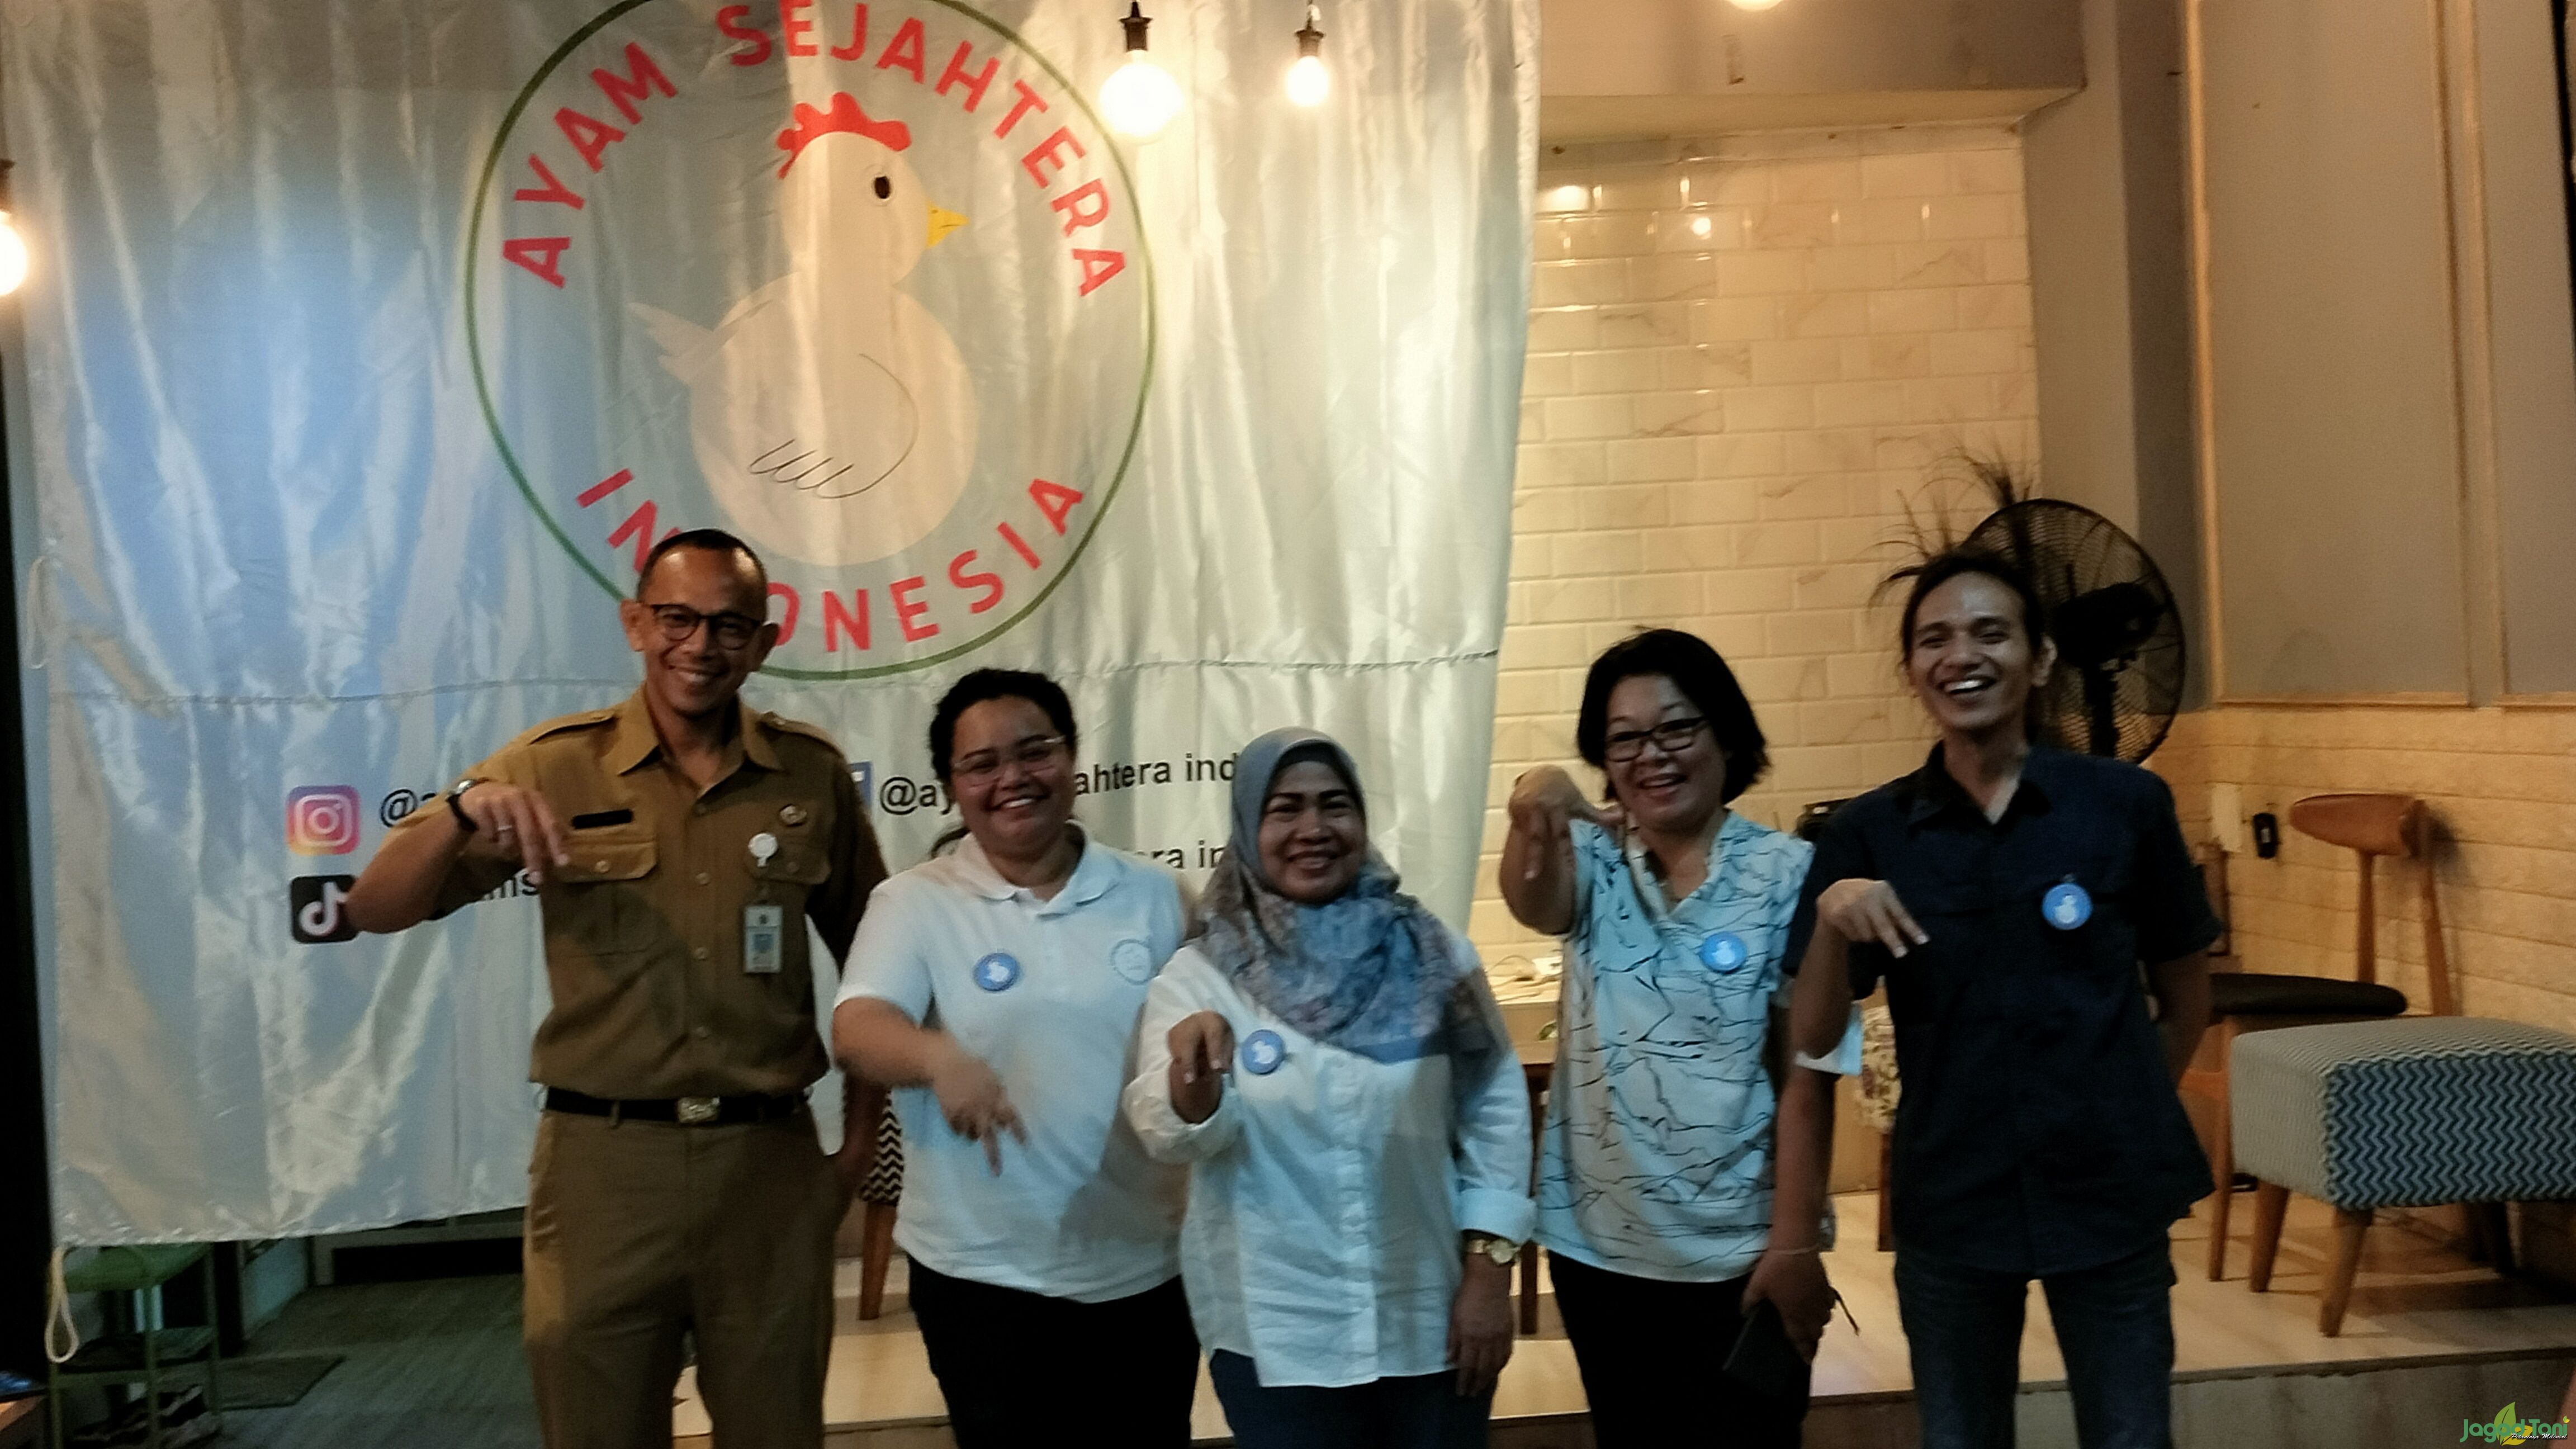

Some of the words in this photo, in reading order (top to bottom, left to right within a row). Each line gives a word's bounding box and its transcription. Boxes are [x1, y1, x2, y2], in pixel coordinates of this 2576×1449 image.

[503, 42, 678, 288] AYAM
[715, 0, 1126, 296] SEJAHTERA
[576, 468, 1083, 652] INONESIA
